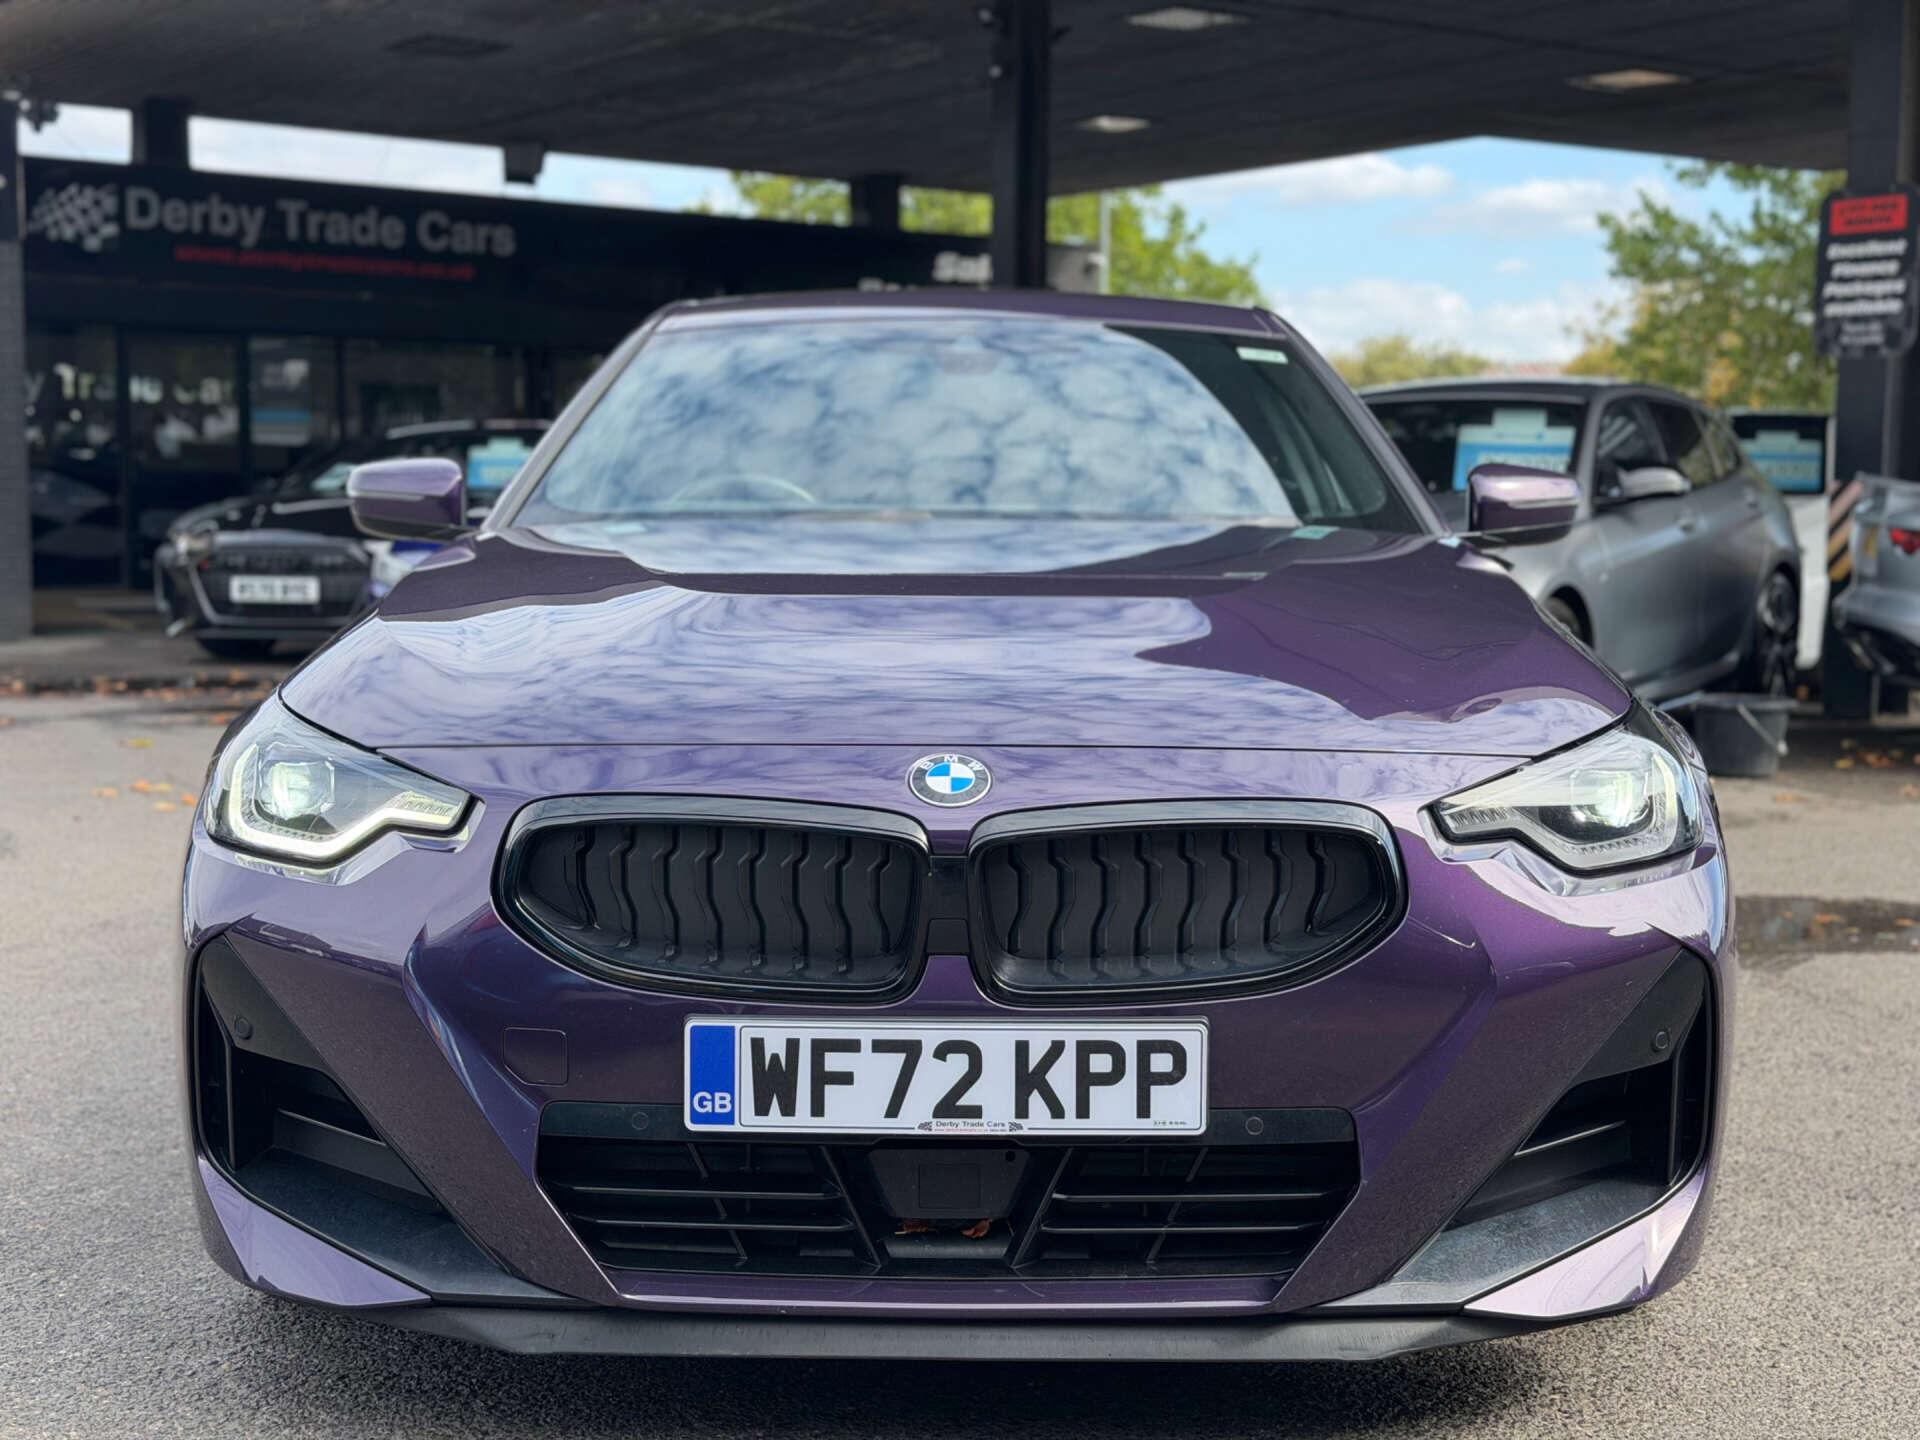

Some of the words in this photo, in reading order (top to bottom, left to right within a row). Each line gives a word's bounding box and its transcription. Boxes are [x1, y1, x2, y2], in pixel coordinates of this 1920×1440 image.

[126, 187, 265, 248] Derby
[278, 200, 406, 248] Trade
[416, 213, 517, 258] Cars
[920, 753, 985, 771] BMW
[750, 1036, 983, 1119] WF72
[1014, 1038, 1187, 1120] KPP
[693, 1092, 732, 1113] GB
[935, 1120, 960, 1128] Derby
[963, 1120, 985, 1128] Trade
[986, 1120, 1006, 1128] Cars
